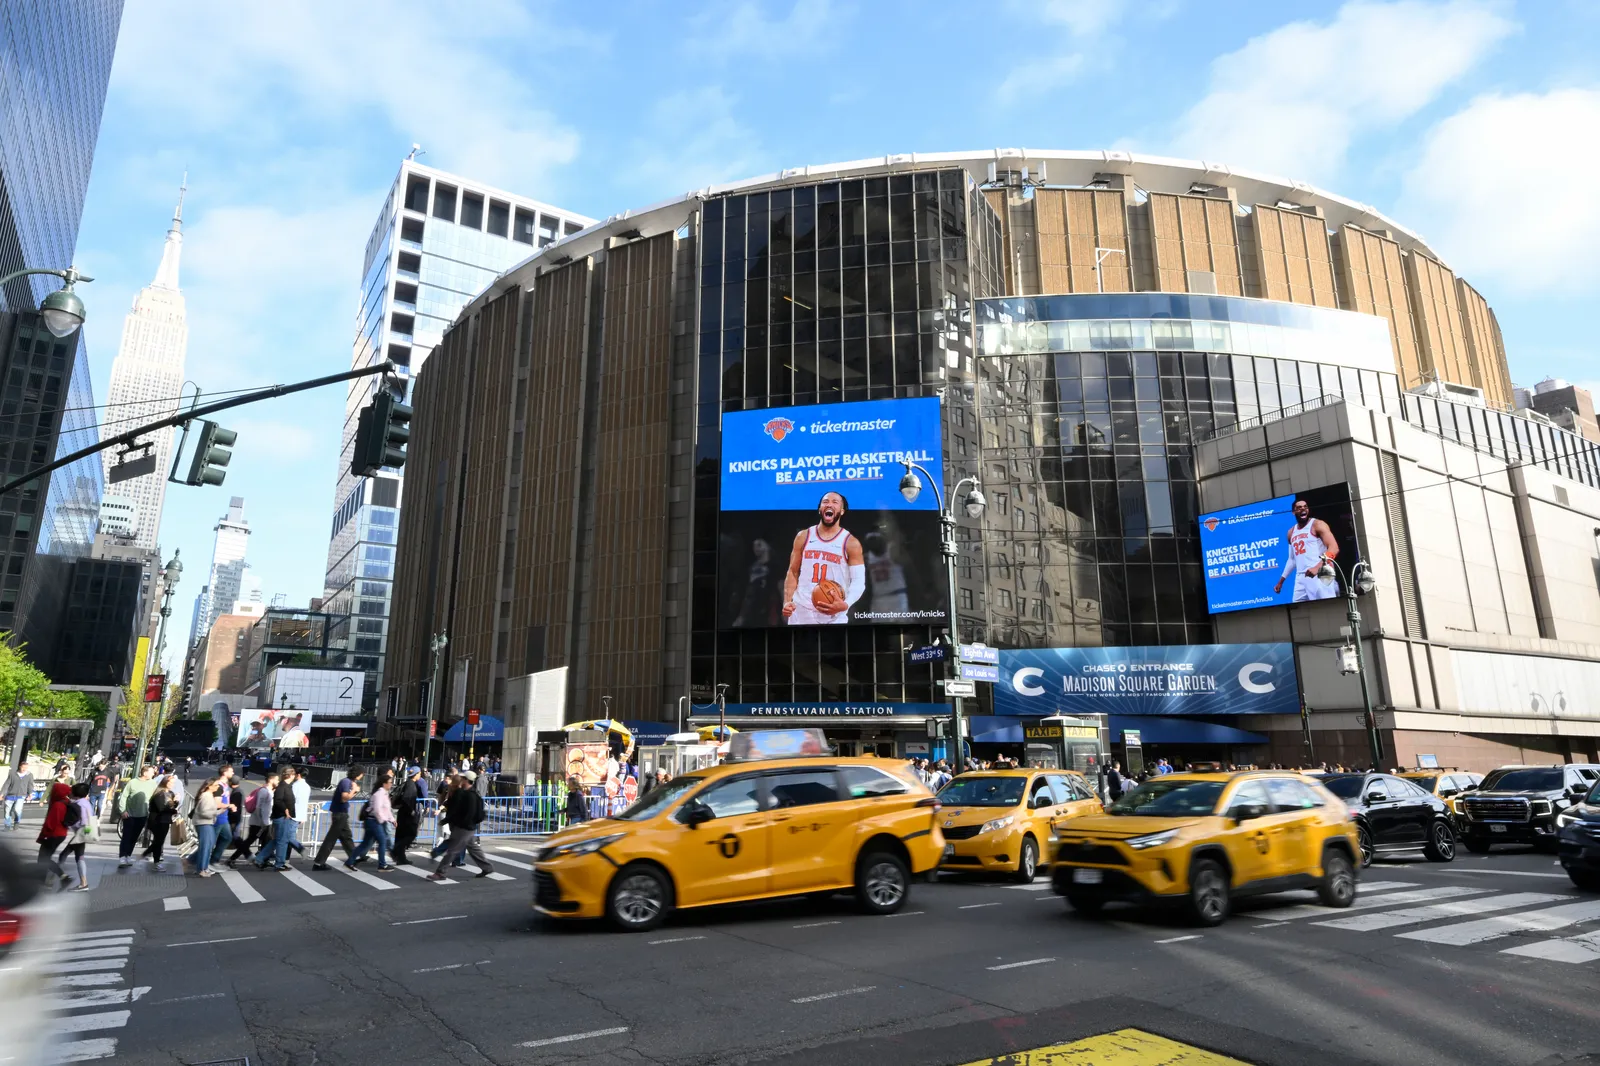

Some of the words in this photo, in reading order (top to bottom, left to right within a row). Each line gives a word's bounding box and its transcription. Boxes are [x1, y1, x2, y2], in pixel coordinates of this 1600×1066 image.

[810, 418, 896, 434] ticketmaster
[729, 459, 778, 473] KNICKS
[780, 455, 840, 469] PLAYOFF
[842, 450, 934, 466] BASKETBALL.
[776, 471, 792, 483] BE
[795, 470, 806, 482] A
[808, 468, 842, 481] PART
[846, 467, 864, 479] OF
[868, 466, 884, 478] IT.
[1206, 545, 1238, 558] KNICKS
[1239, 537, 1280, 552] PLAYOFF
[1293, 540, 1306, 556] 32
[1207, 550, 1264, 566] BASKETBALL.
[812, 562, 828, 583] 11
[1208, 568, 1220, 578] BE
[1220, 567, 1228, 576] A
[1228, 562, 1251, 574] PART
[1252, 560, 1266, 570] OF
[1267, 558, 1279, 568] IT.
[1212, 596, 1274, 608] ticketmaster.com/knicks
[854, 610, 946, 618] ticketmaster.com/knicks
[911, 652, 925, 660] West
[926, 650, 936, 659] 33rd
[937, 649, 944, 658] St
[964, 648, 983, 659] Eighth
[984, 651, 996, 659] Ave
[965, 668, 974, 676] Joe
[974, 669, 988, 678] Louis
[1083, 664, 1116, 672] CHASE
[1130, 664, 1194, 672] ENTRANCE
[1012, 667, 1046, 696] C
[1063, 675, 1116, 692] MADISON
[1119, 674, 1164, 692] SQUARE
[1238, 662, 1276, 694] C
[339, 676, 354, 698] 2
[752, 706, 840, 715] PENNSYLVANIA
[845, 706, 894, 714] STATION
[1028, 728, 1049, 737] TAXI
[1066, 727, 1086, 737] TAXI
[625, 784, 638, 794] STOP
